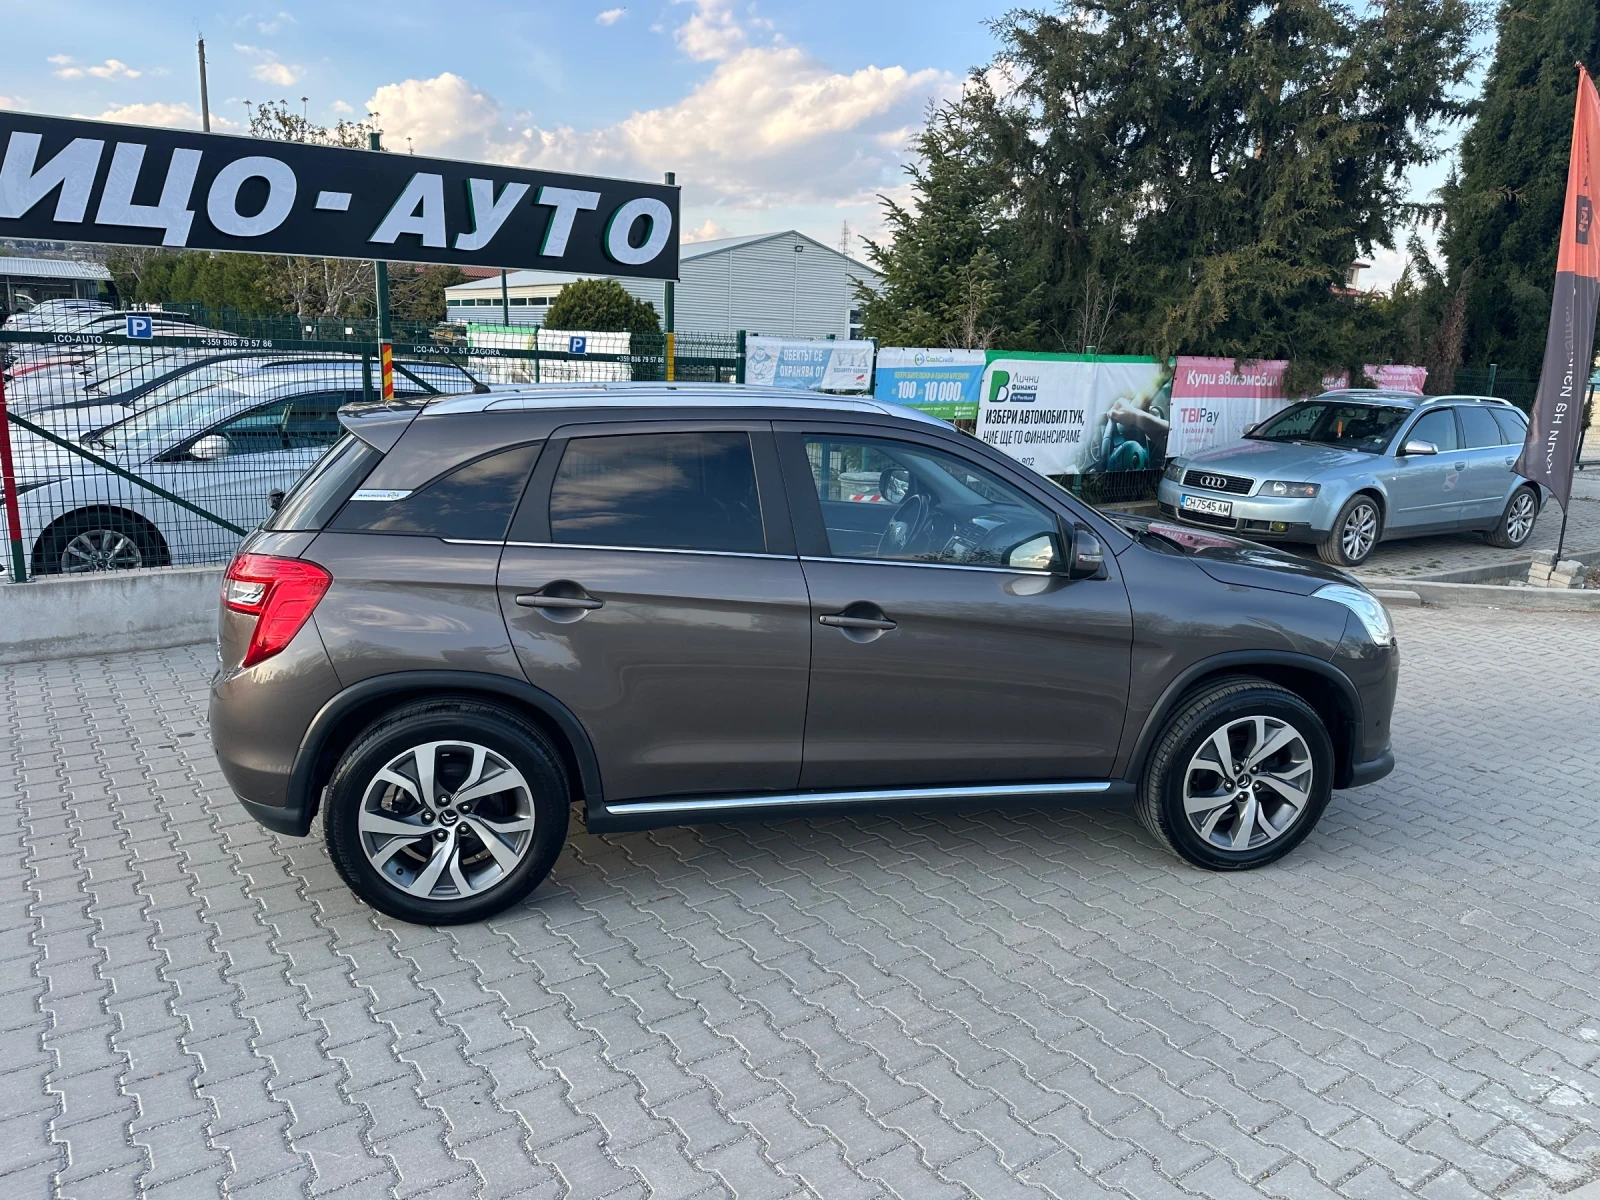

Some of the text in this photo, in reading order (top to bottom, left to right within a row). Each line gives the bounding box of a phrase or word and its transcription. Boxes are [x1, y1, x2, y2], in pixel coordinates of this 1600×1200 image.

[368, 172, 672, 265] АУТО
[132, 318, 146, 336] P
[470, 348, 500, 356] ZAGORA
[572, 338, 583, 352] P
[784, 349, 822, 361] ОБЕКТЪТ СЕ
[780, 366, 824, 377] ОХРАНЯВА ОТ
[1012, 372, 1039, 384] Лични
[1187, 370, 1216, 388] Купи
[898, 381, 916, 398] 100
[925, 381, 938, 401] 10
[938, 382, 962, 401] 000
[985, 410, 1084, 426] ИЗБЕРИ АВТОМОБИЛ ТУК,
[1180, 408, 1220, 425] TBIPay
[983, 430, 1081, 446] НИЕ ЩЕ ГО ФИНАНСИРАМЕ
[1185, 498, 1229, 514] CH 7545 AM
